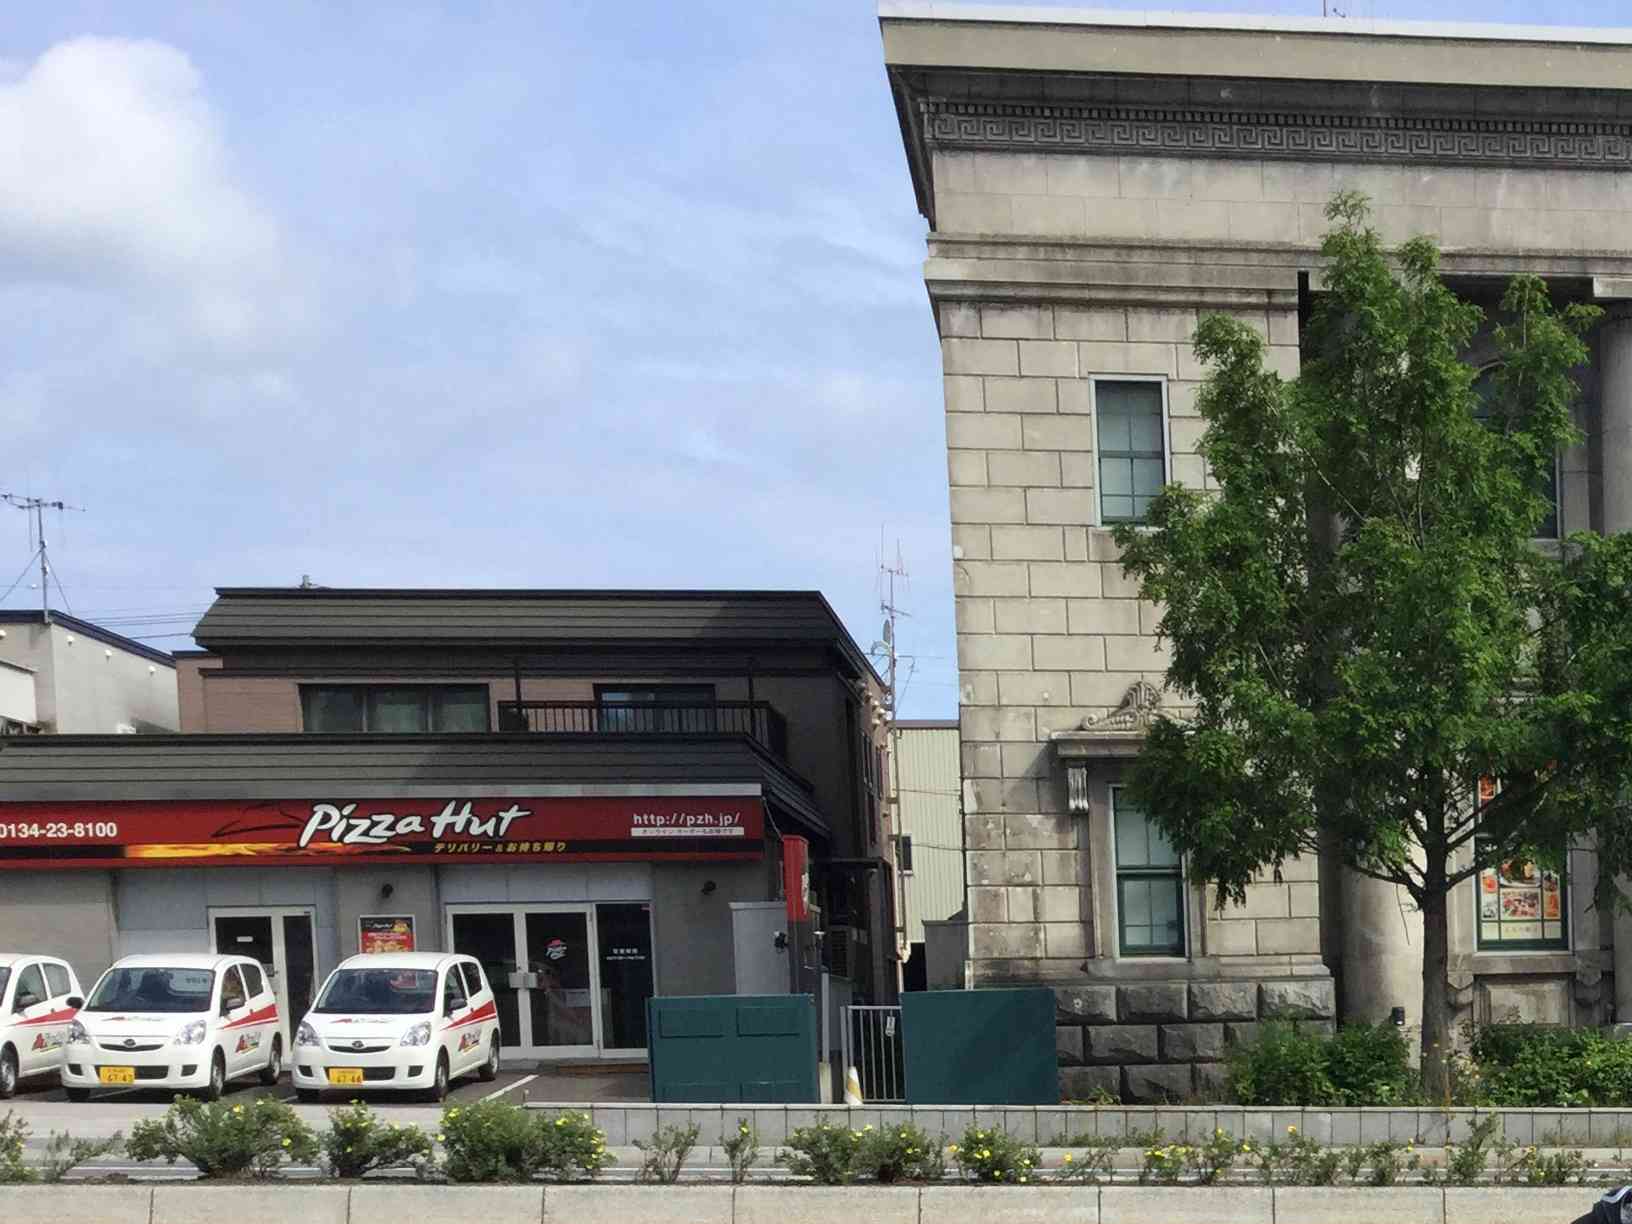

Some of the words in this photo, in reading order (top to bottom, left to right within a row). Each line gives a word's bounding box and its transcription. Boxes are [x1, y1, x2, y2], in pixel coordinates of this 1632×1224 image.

[299, 803, 426, 848] Pizza
[431, 800, 531, 839] Hut
[633, 812, 741, 827] http://pzh.jp/
[0, 822, 117, 839] 0134-23-8100
